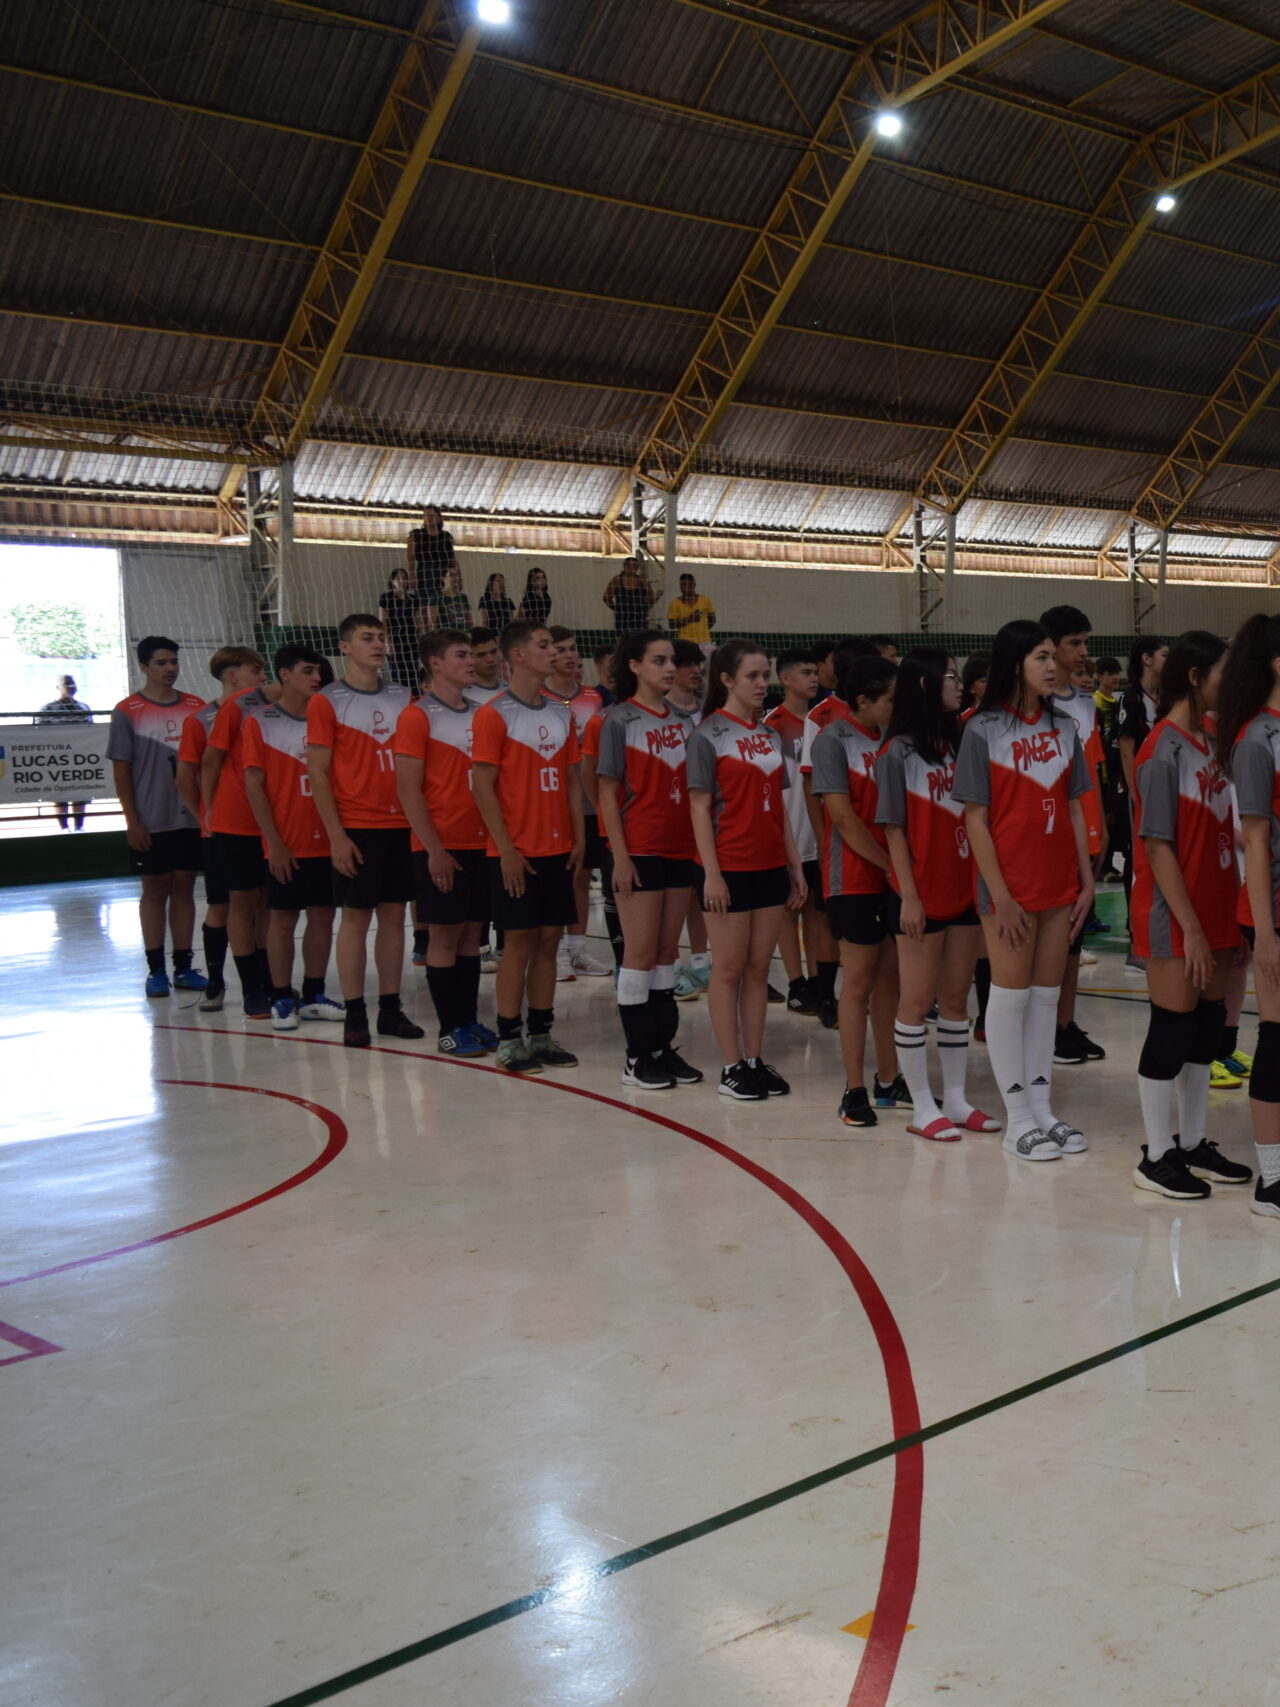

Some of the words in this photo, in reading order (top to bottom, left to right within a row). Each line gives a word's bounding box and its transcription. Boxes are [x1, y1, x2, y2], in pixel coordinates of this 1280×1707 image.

[11, 744, 72, 752] PREFEITURA
[12, 754, 69, 768] LUCAS
[74, 753, 100, 766] DO
[376, 748, 395, 772] 11
[1011, 728, 1062, 774] PIAGET
[14, 771, 43, 783] RIO
[48, 768, 105, 782] VERDE
[669, 776, 682, 804] 4
[1043, 798, 1055, 835] 7
[955, 826, 969, 859] 9
[1218, 832, 1232, 870] 6
